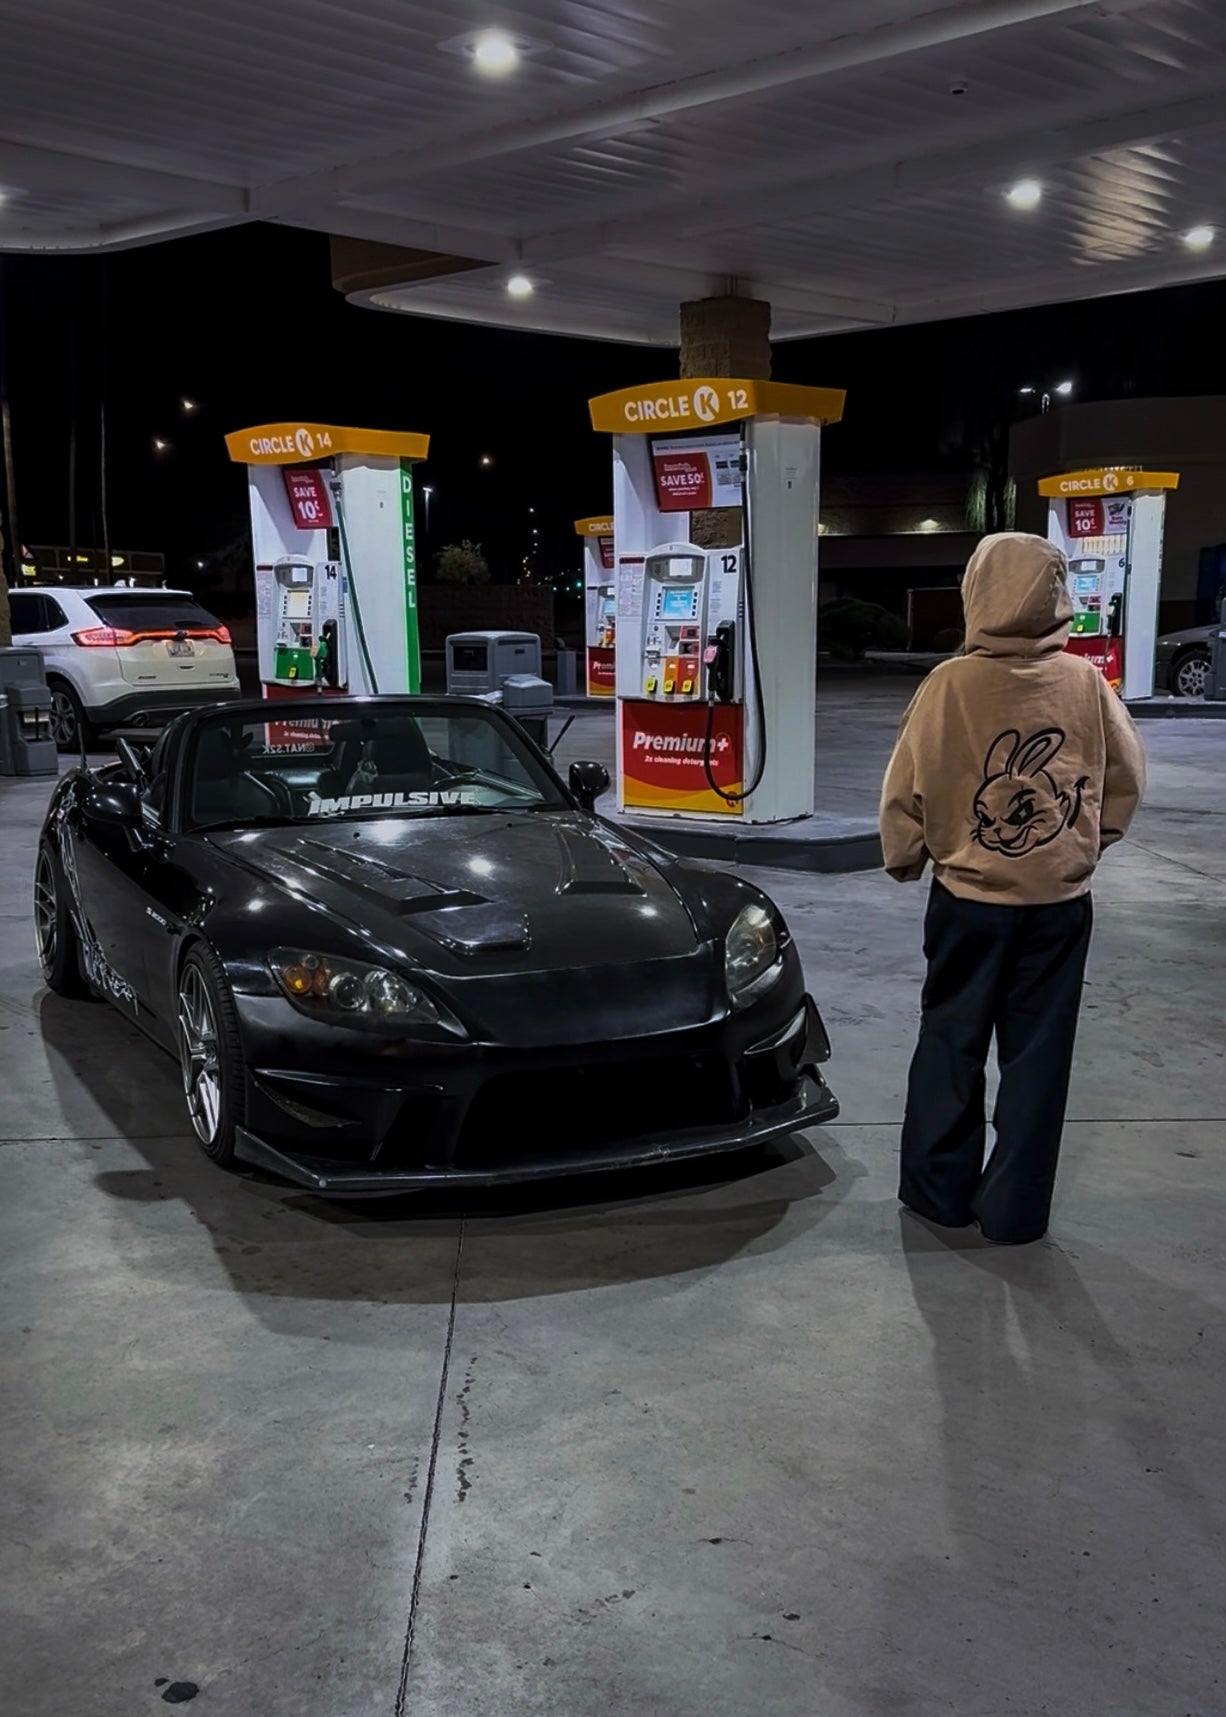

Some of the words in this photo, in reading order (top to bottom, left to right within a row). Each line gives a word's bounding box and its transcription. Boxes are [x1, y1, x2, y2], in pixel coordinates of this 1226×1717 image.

[624, 395, 690, 422] CIRCLE
[728, 389, 749, 410] 12
[250, 435, 295, 455] CIRCLE
[316, 432, 332, 449] 14
[660, 474, 687, 487] SAVE
[1060, 479, 1100, 492] CIRCLE
[1126, 475, 1134, 486] 6
[293, 486, 317, 498] SAVE
[1075, 509, 1096, 518] SAVE
[402, 475, 416, 608] DIESEL
[721, 555, 737, 574] 12
[1118, 557, 1126, 568] 6
[325, 564, 337, 580] 14
[682, 757, 719, 767] detergnts
[307, 791, 475, 817] IMPULSIVE
